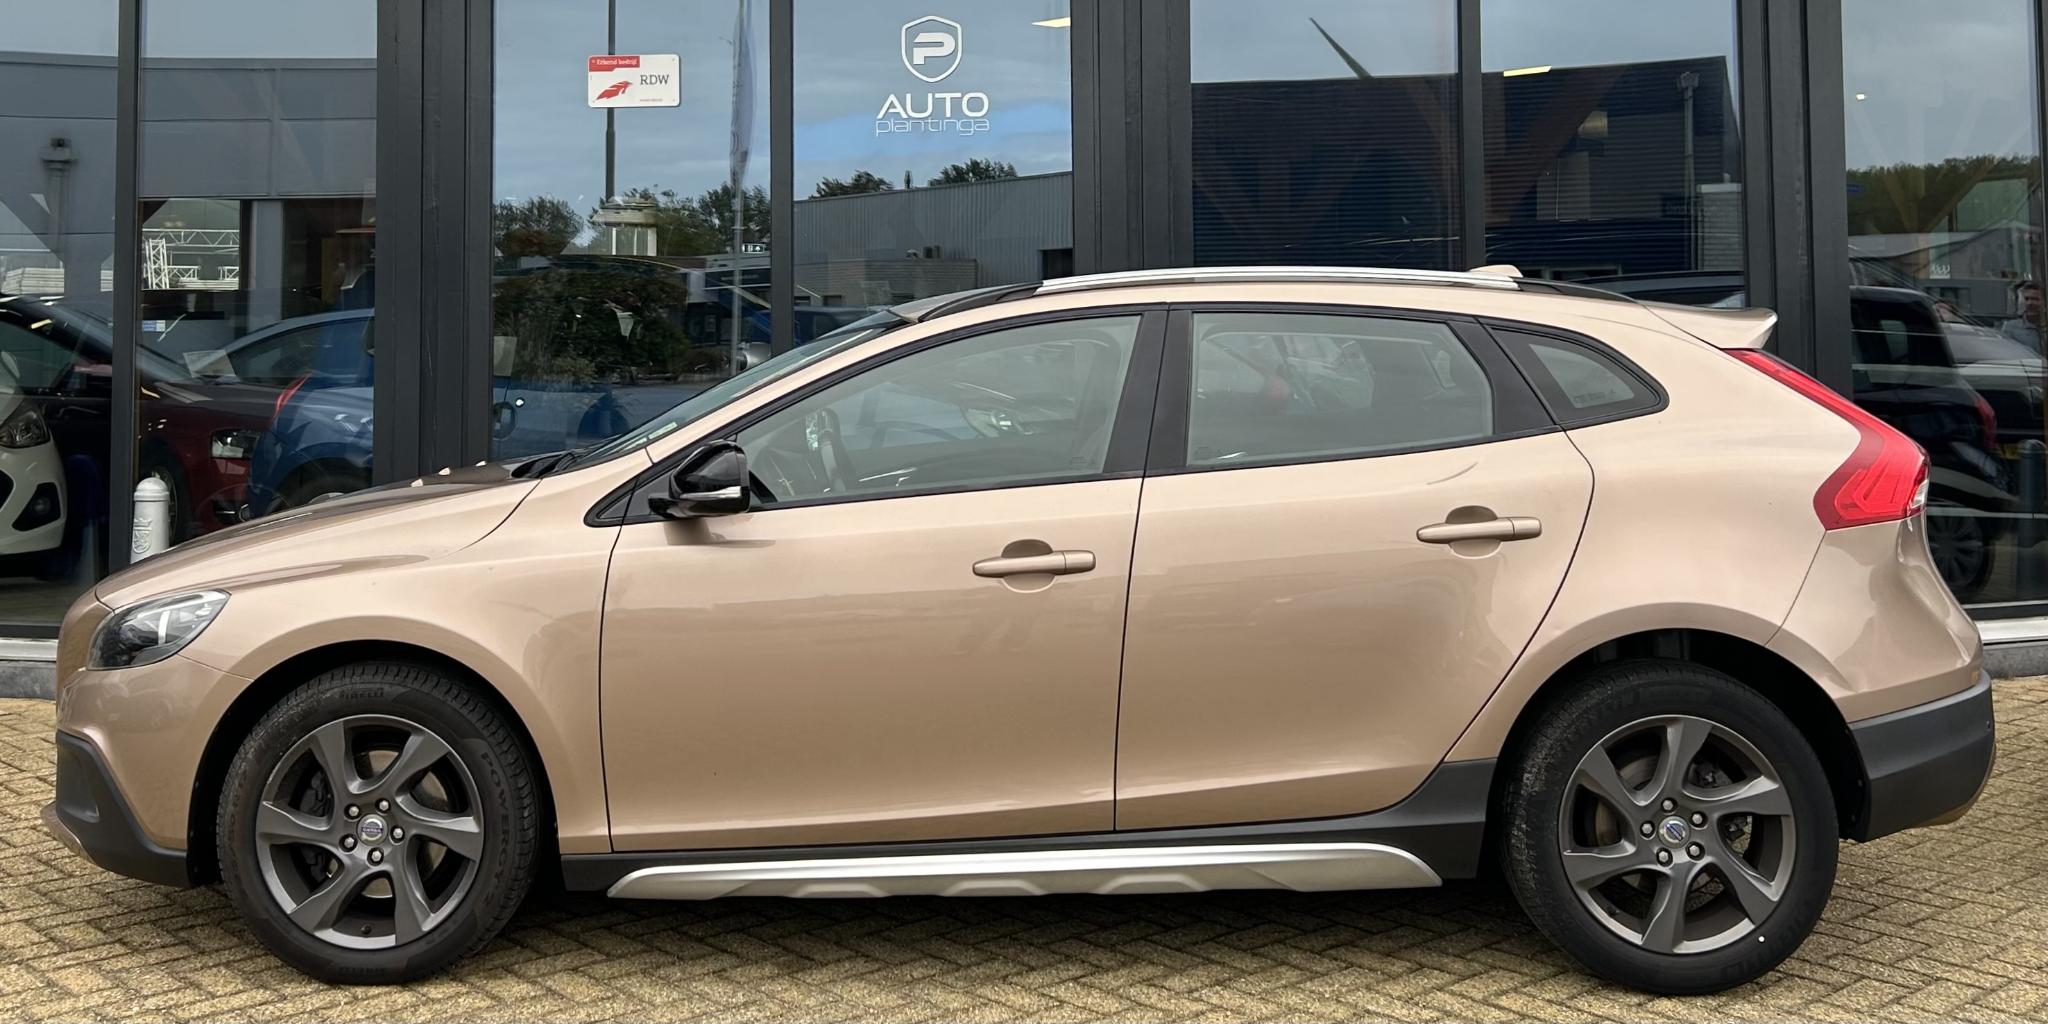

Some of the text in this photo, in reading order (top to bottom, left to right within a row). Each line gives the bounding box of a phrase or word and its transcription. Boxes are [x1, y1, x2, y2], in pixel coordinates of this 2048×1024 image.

[913, 32, 956, 65] P
[640, 74, 670, 85] RDW
[876, 92, 989, 118] AUTO
[875, 117, 990, 136] plantinga
